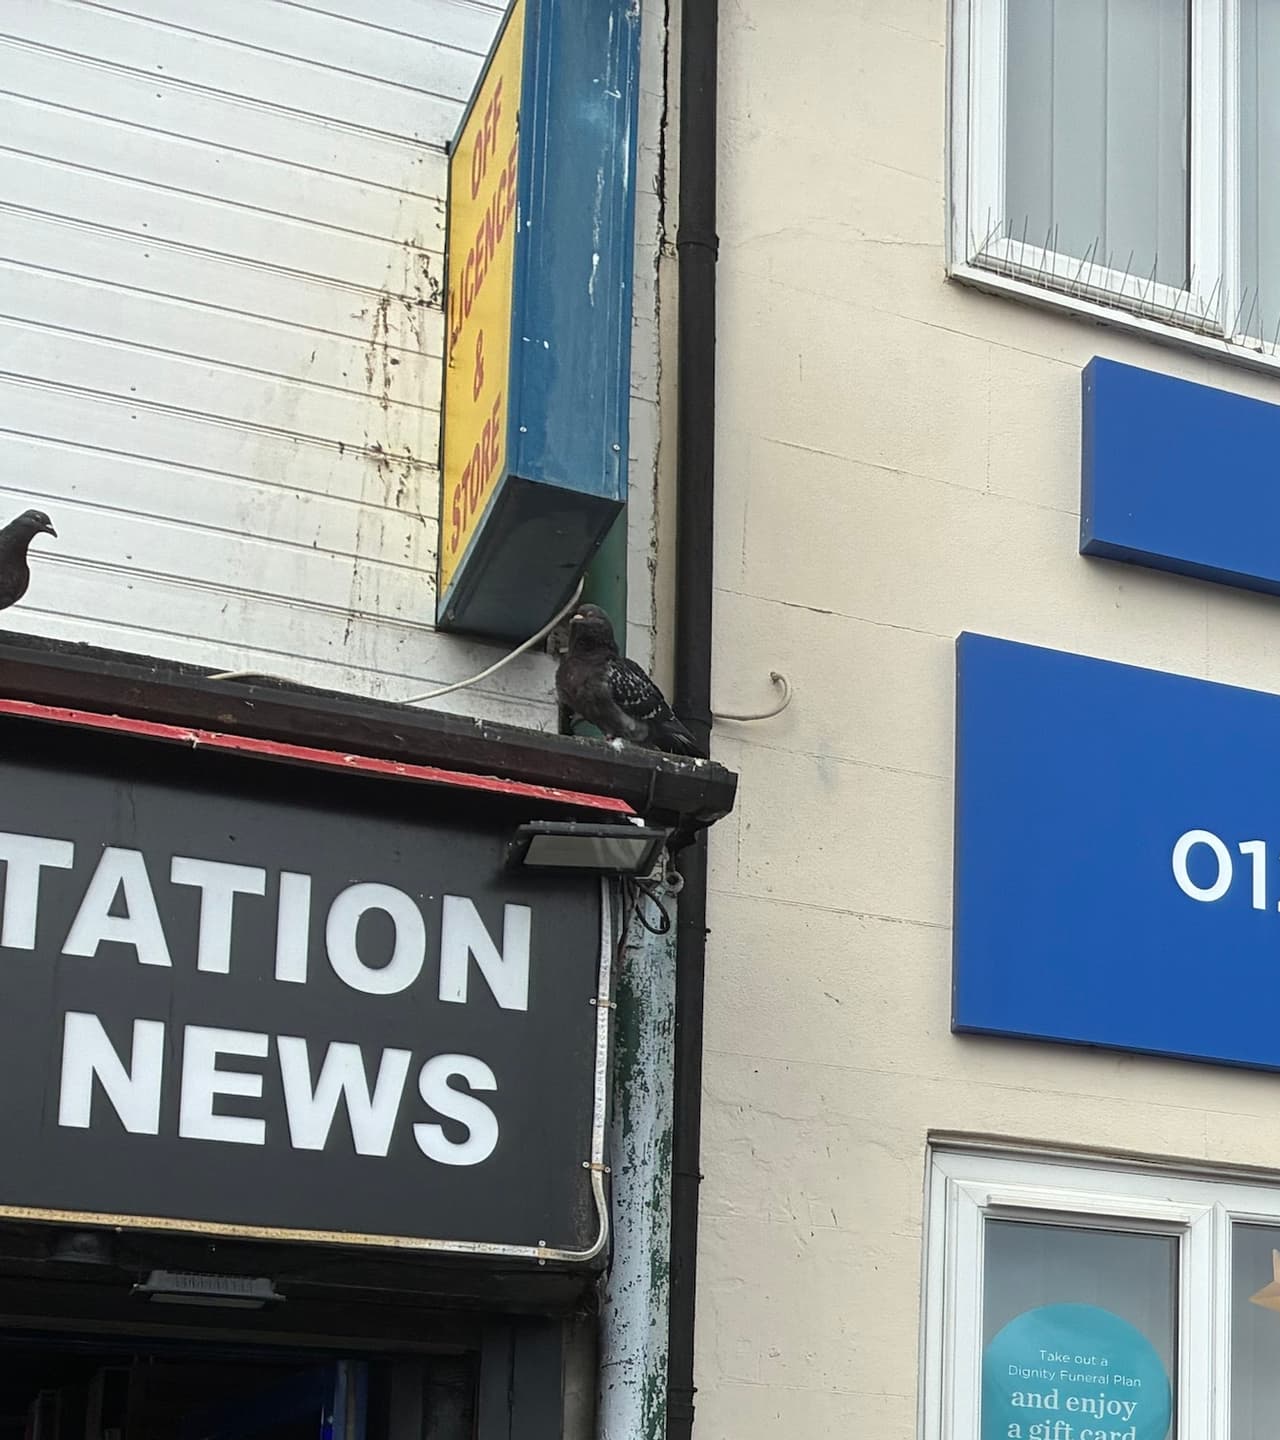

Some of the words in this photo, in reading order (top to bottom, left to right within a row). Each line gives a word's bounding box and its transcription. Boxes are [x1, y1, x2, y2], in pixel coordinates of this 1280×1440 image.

[471, 75, 503, 200] OFF
[449, 137, 518, 345] LICENCE
[472, 329, 485, 402] &
[450, 400, 502, 553] STORE
[58, 1010, 500, 1167] NEWS
[1008, 1364, 1056, 1382] Dignity
[1059, 1370, 1109, 1385] Funeral
[1113, 1374, 1142, 1388] Plan
[1040, 1349, 1070, 1364] Take
[1074, 1353, 1096, 1366] out
[1007, 1423, 1022, 1439] a
[1011, 1389, 1059, 1411] and
[1065, 1392, 1137, 1422] enjoy
